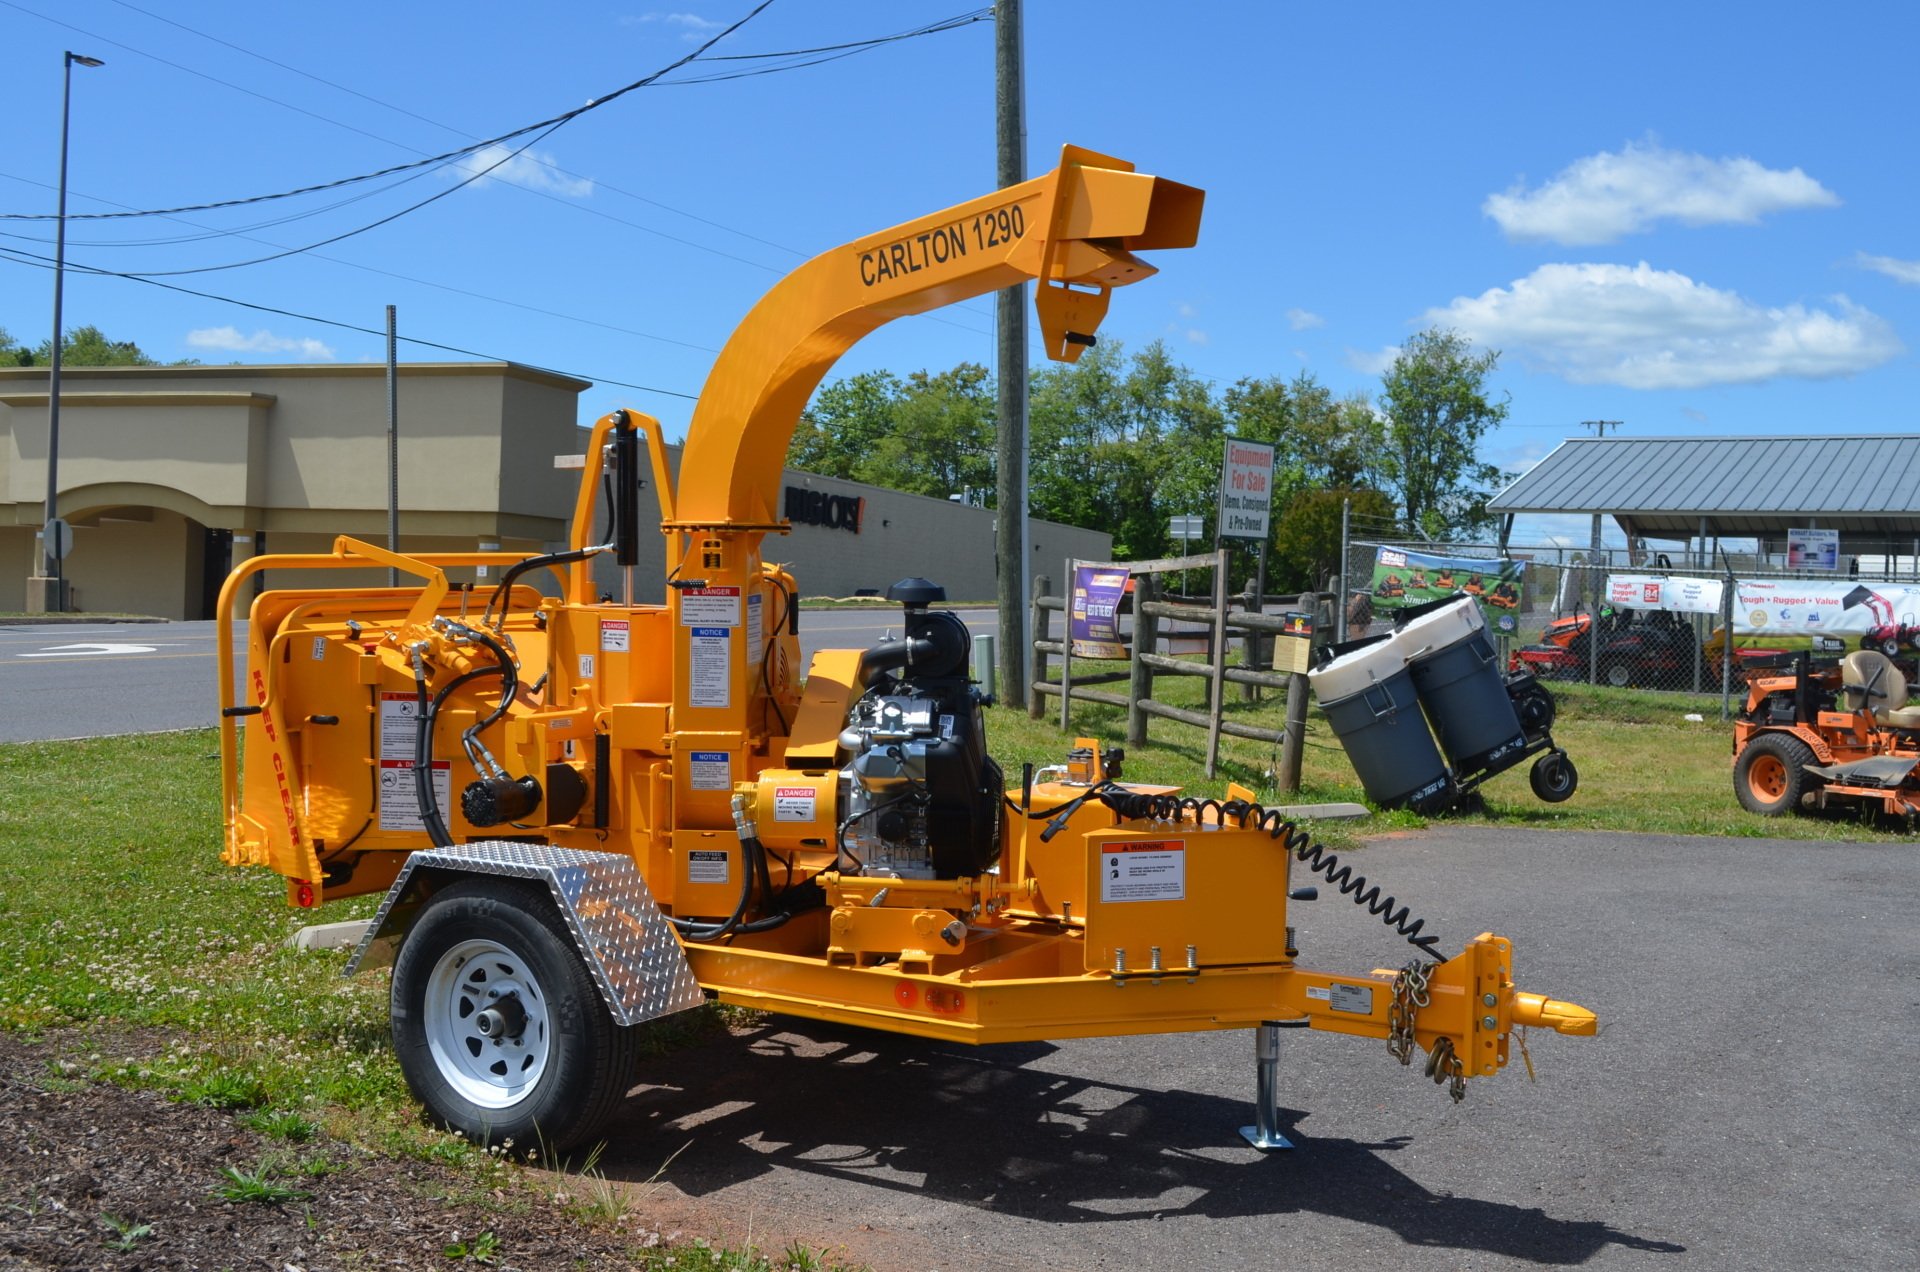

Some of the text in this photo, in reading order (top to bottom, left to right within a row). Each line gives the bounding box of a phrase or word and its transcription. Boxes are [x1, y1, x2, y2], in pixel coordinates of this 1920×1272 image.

[860, 204, 1024, 287] CARLTON 1290
[1230, 445, 1271, 468] Equipment
[1232, 469, 1265, 492] For Sale
[1644, 589, 1658, 598] 84
[1740, 596, 1765, 605] Tough
[1773, 596, 1806, 605] Rugged
[1815, 597, 1840, 605] Value
[607, 622, 627, 630] DANGER
[253, 670, 277, 742] KEEP
[273, 752, 300, 846] CLEAR
[1130, 842, 1165, 851] WARNING
